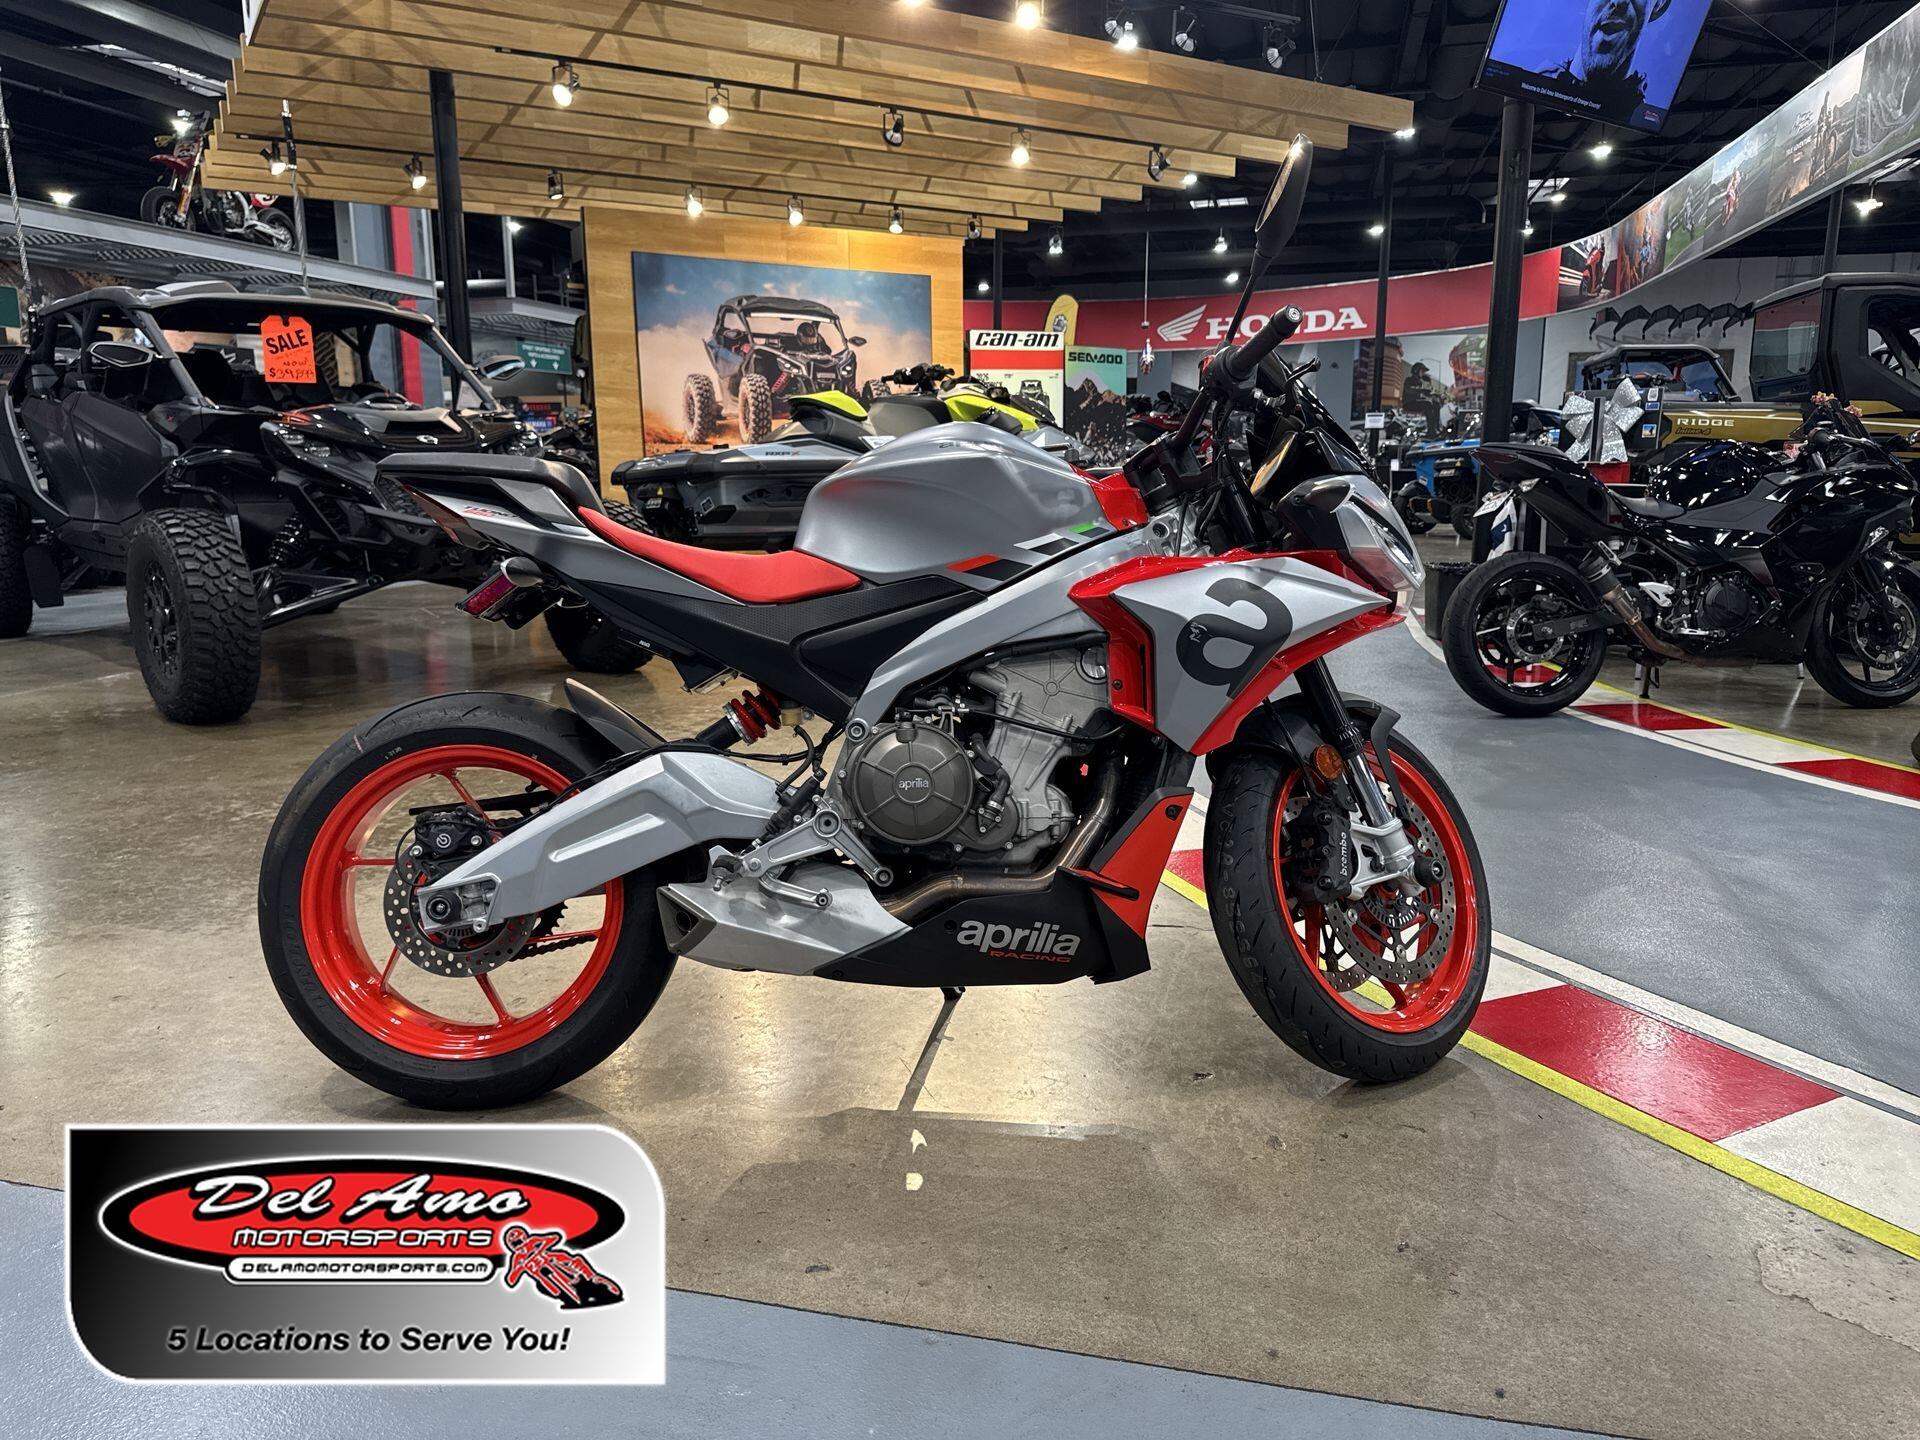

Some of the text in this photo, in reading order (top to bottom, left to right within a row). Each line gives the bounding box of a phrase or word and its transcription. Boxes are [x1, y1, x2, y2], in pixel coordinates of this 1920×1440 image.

[1206, 307, 1367, 340] HODA
[265, 328, 309, 355] SALE
[1677, 418, 1734, 427] RIDGE
[898, 777, 929, 791] aprilia
[1339, 831, 1348, 876] brembo
[956, 919, 1081, 956] aprilia
[989, 950, 1073, 963] RACING
